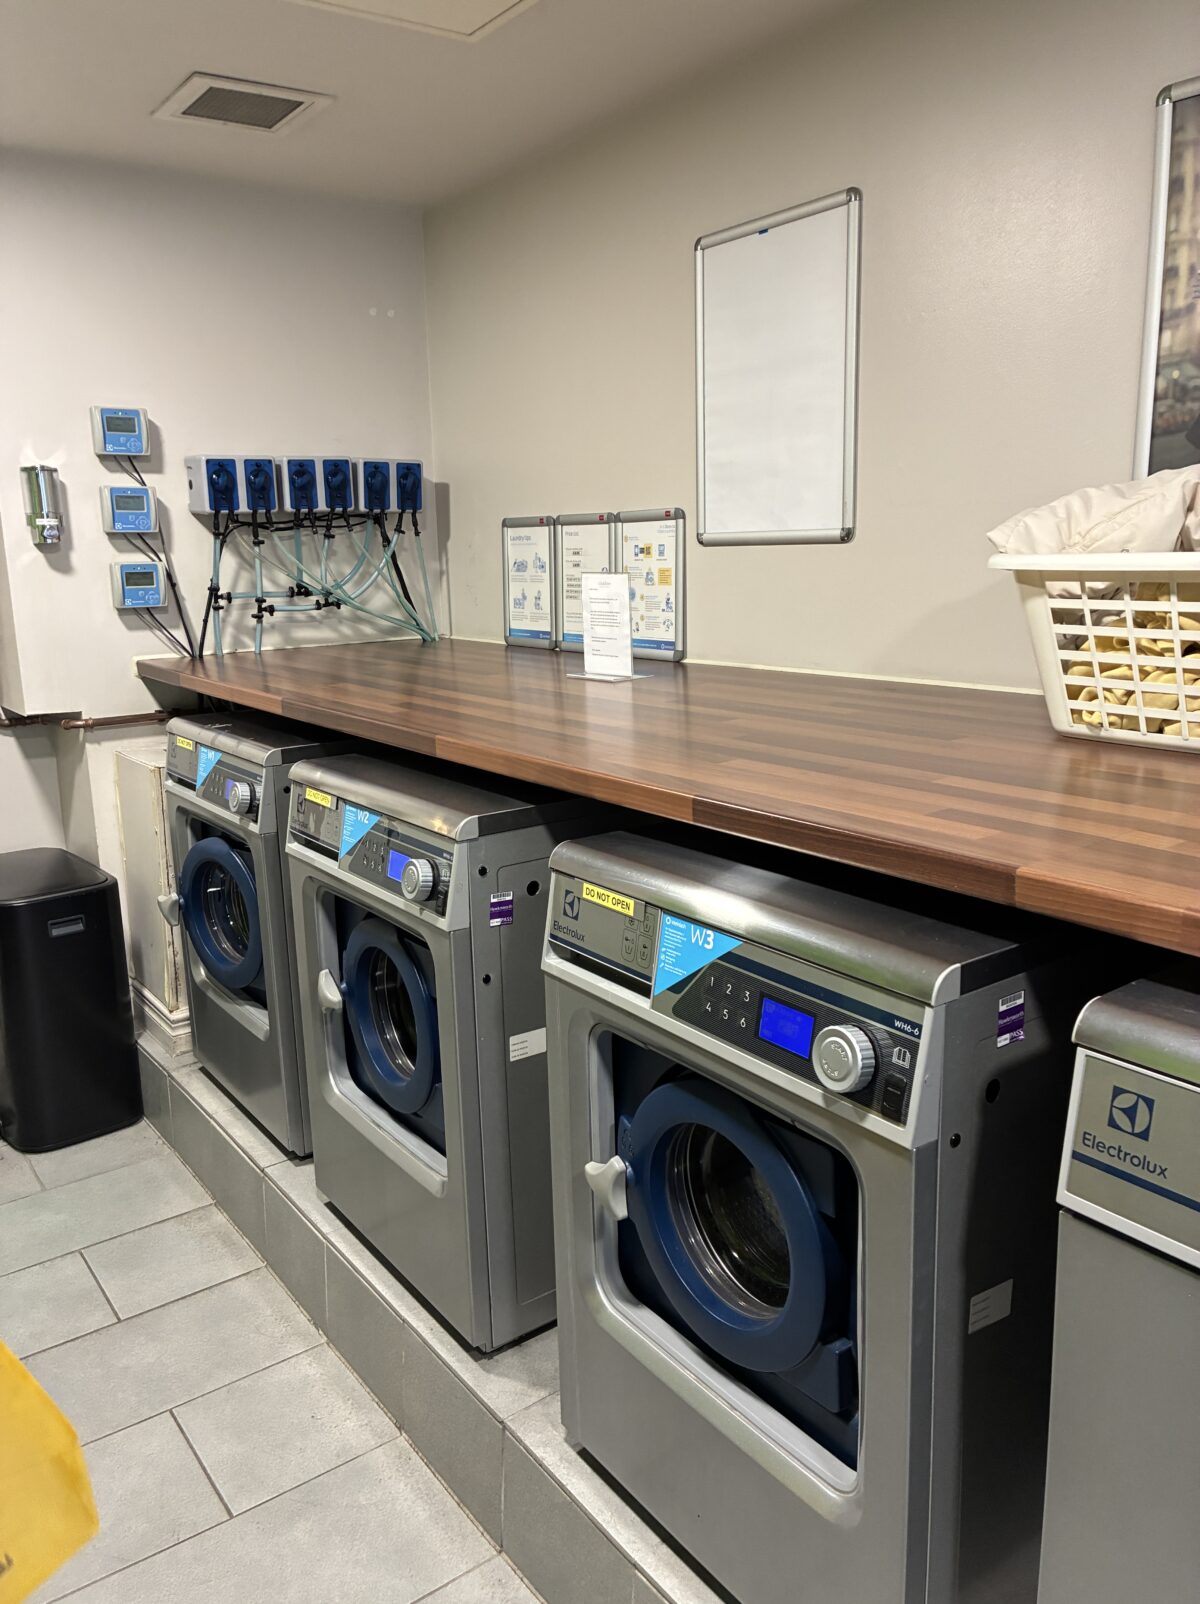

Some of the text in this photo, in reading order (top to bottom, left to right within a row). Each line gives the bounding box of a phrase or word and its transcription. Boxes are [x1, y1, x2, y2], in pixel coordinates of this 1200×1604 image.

[357, 809, 370, 824] W2
[585, 887, 631, 911] DO NOT OPEN
[553, 920, 585, 942] Electrolux
[690, 924, 714, 950] W3
[710, 976, 750, 1002] 1 2 3
[705, 1001, 746, 1028] 4 5 6
[894, 1019, 920, 1036] WH6-6
[1081, 1131, 1168, 1180] Electrolux
